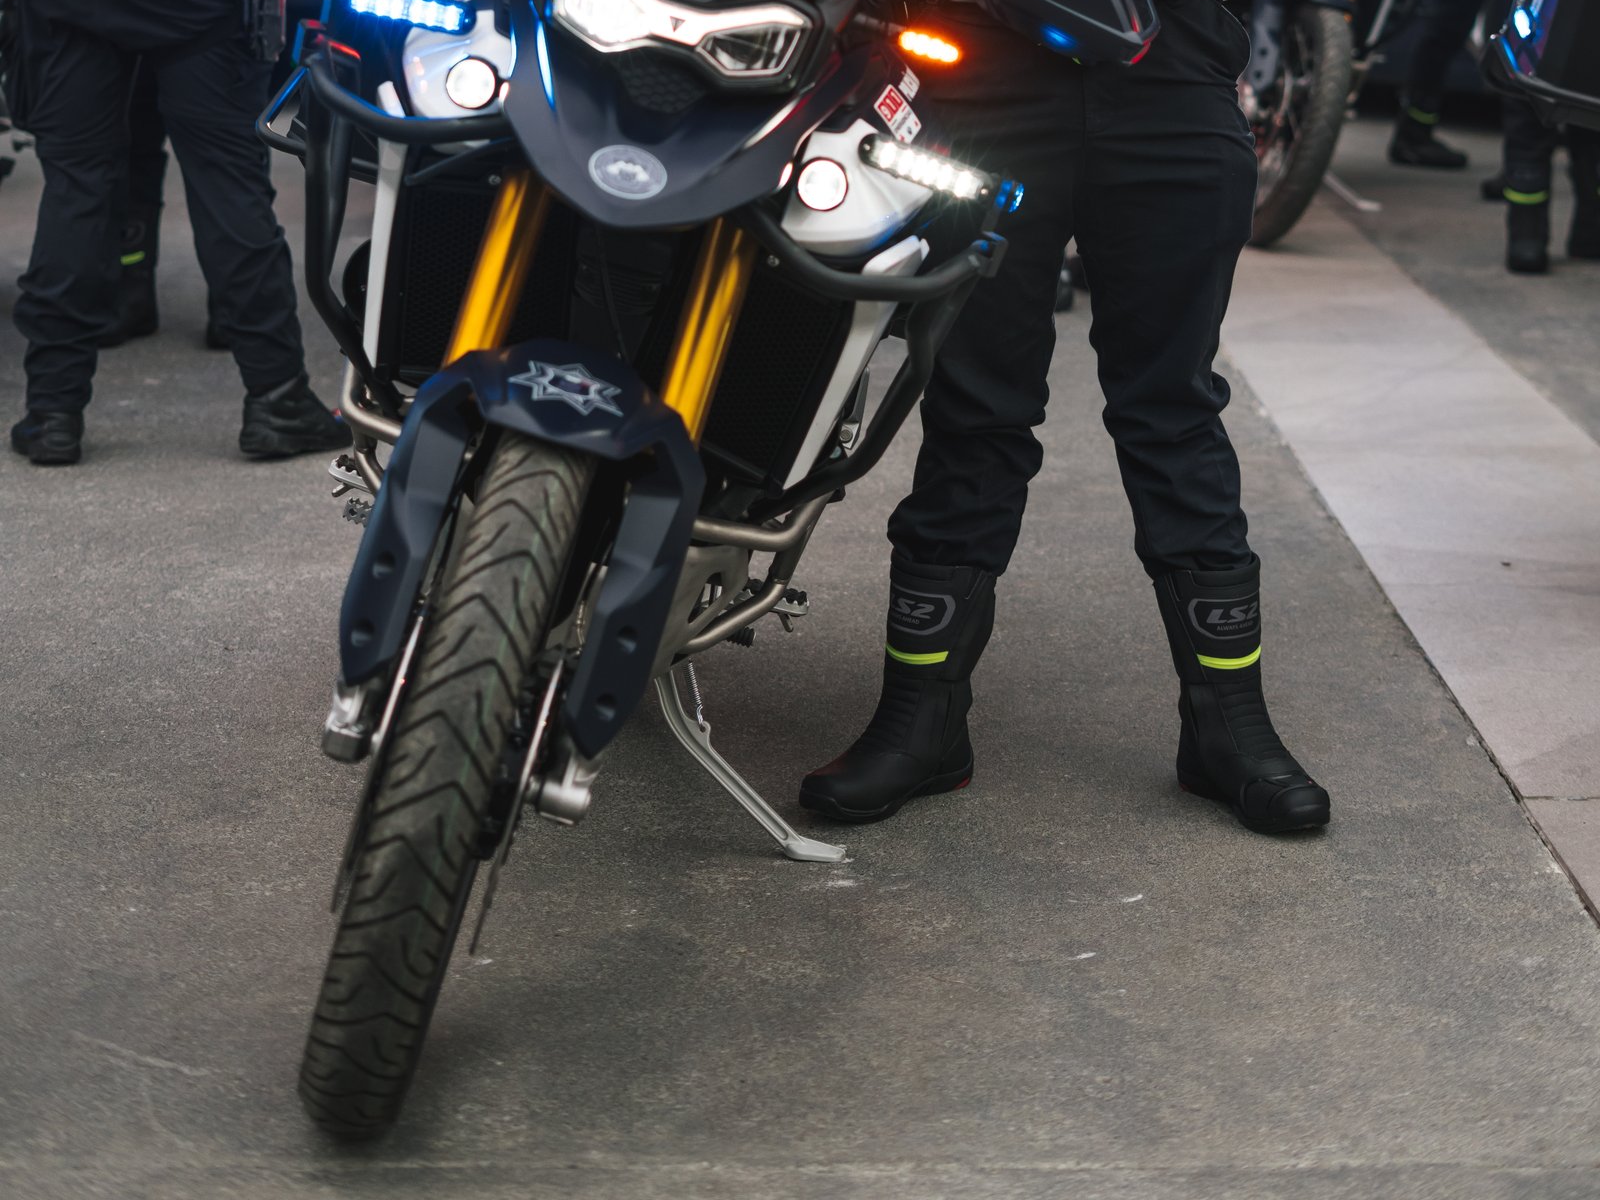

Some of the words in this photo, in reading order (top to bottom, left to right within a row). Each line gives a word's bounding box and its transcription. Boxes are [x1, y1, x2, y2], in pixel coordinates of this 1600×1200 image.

[879, 90, 902, 120] 911
[891, 597, 935, 619] S2
[1206, 601, 1258, 624] LS2
